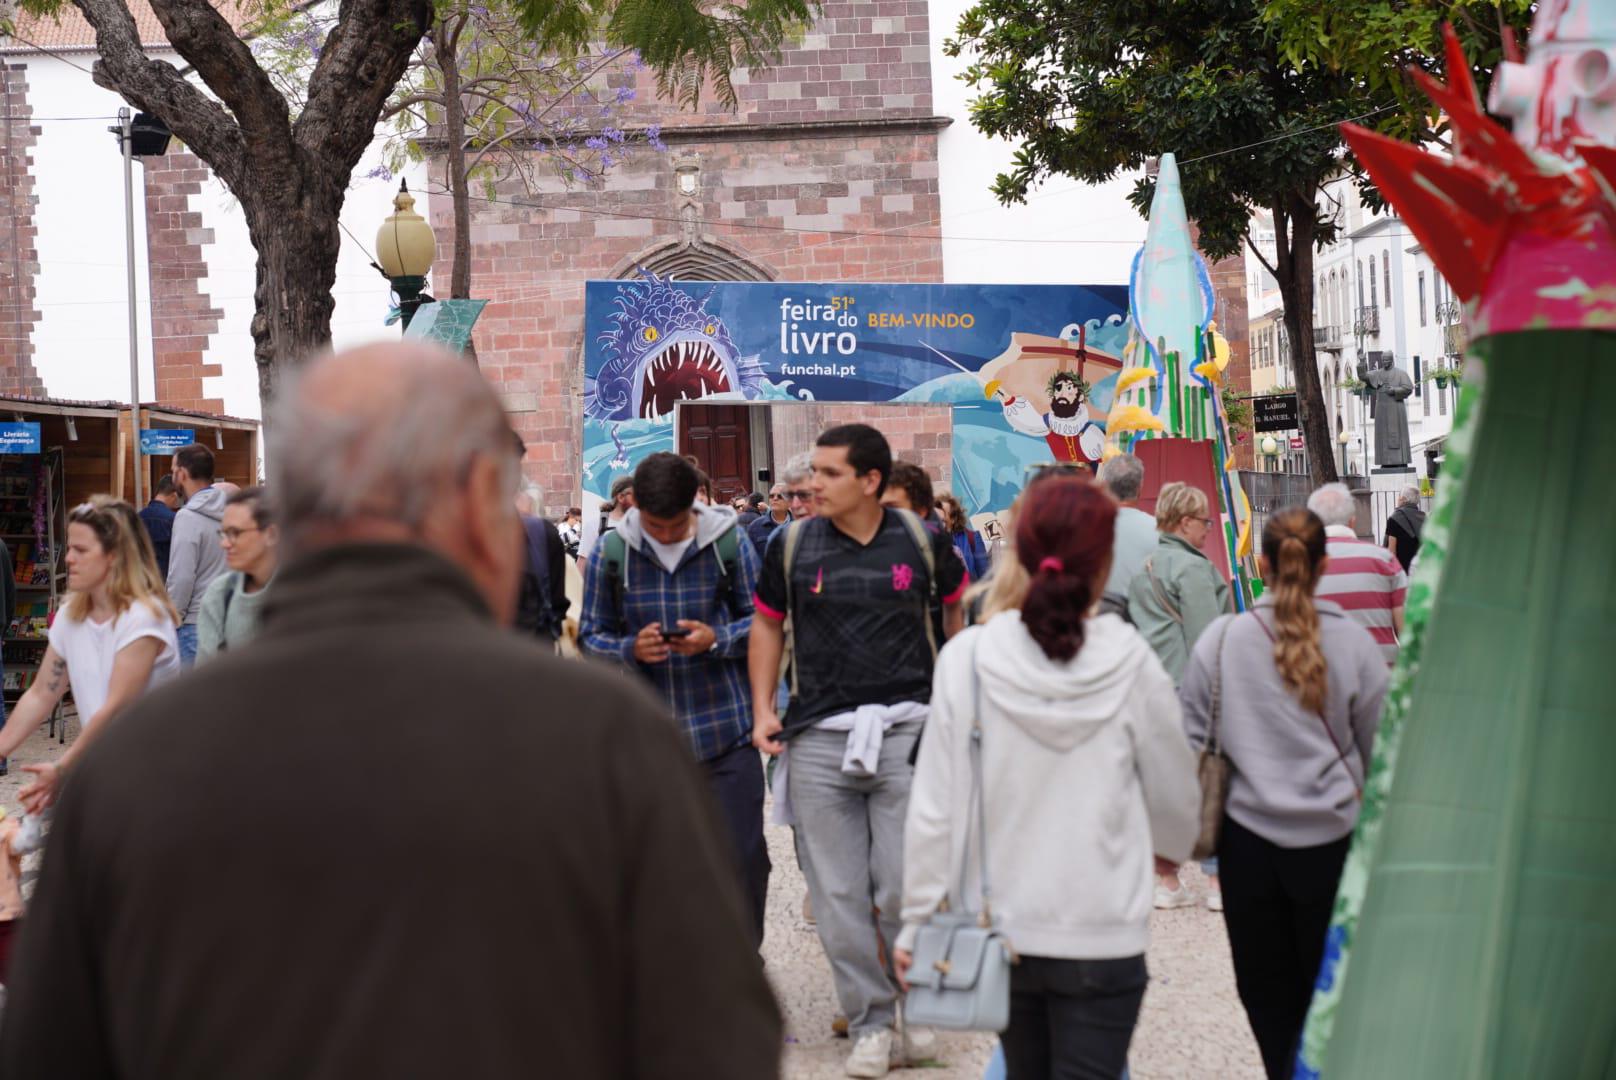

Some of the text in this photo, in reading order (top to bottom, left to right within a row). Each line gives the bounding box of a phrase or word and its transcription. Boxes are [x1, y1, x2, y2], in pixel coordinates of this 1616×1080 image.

[780, 298, 858, 327] feira do
[867, 313, 975, 328] BEM-VINDO
[780, 322, 857, 355] livro
[781, 363, 856, 378] funchal.pt
[1264, 402, 1287, 410] LARGO
